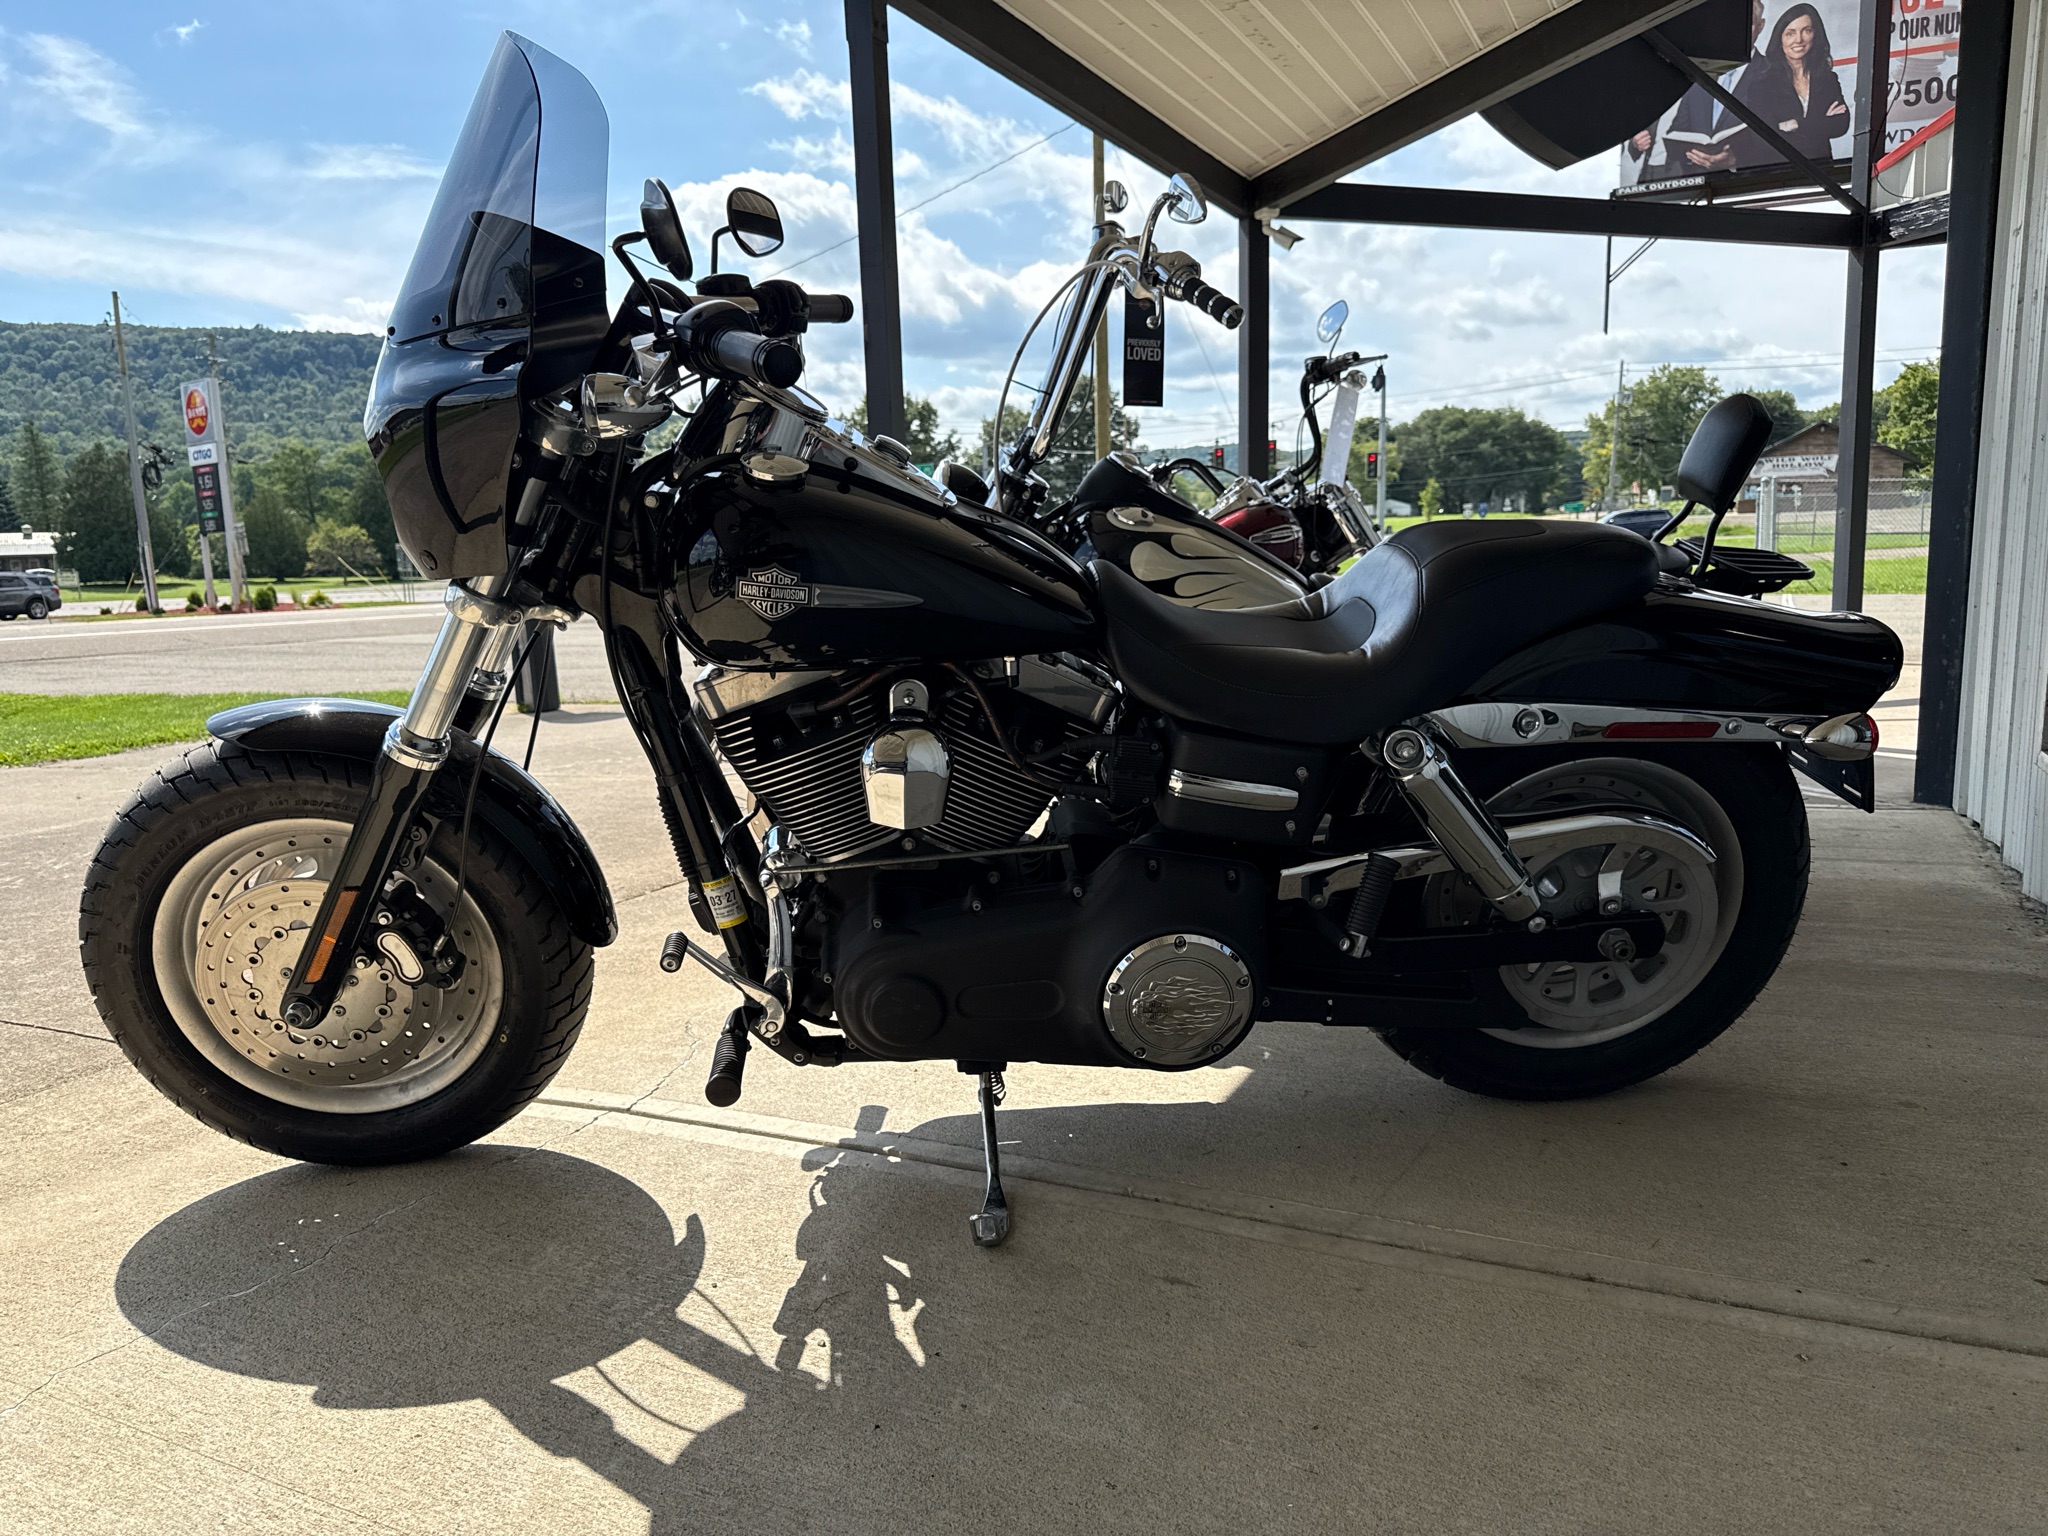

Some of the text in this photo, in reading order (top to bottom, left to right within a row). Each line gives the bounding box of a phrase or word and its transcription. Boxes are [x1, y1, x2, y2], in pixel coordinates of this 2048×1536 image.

[1899, 16, 1931, 41] OUR
[1885, 126, 1926, 145] WD
[1618, 176, 1704, 195] PARK OUTDOOR
[1127, 338, 1161, 347] PREVIOUSLY
[1127, 347, 1161, 361] LOVED
[192, 448, 212, 461] CITGO
[757, 572, 791, 585] MOTOR
[742, 584, 805, 600] HARLEY-DAVIDSON
[756, 600, 789, 615] CYCLES
[710, 895, 723, 907] 03
[725, 890, 737, 903] 27
